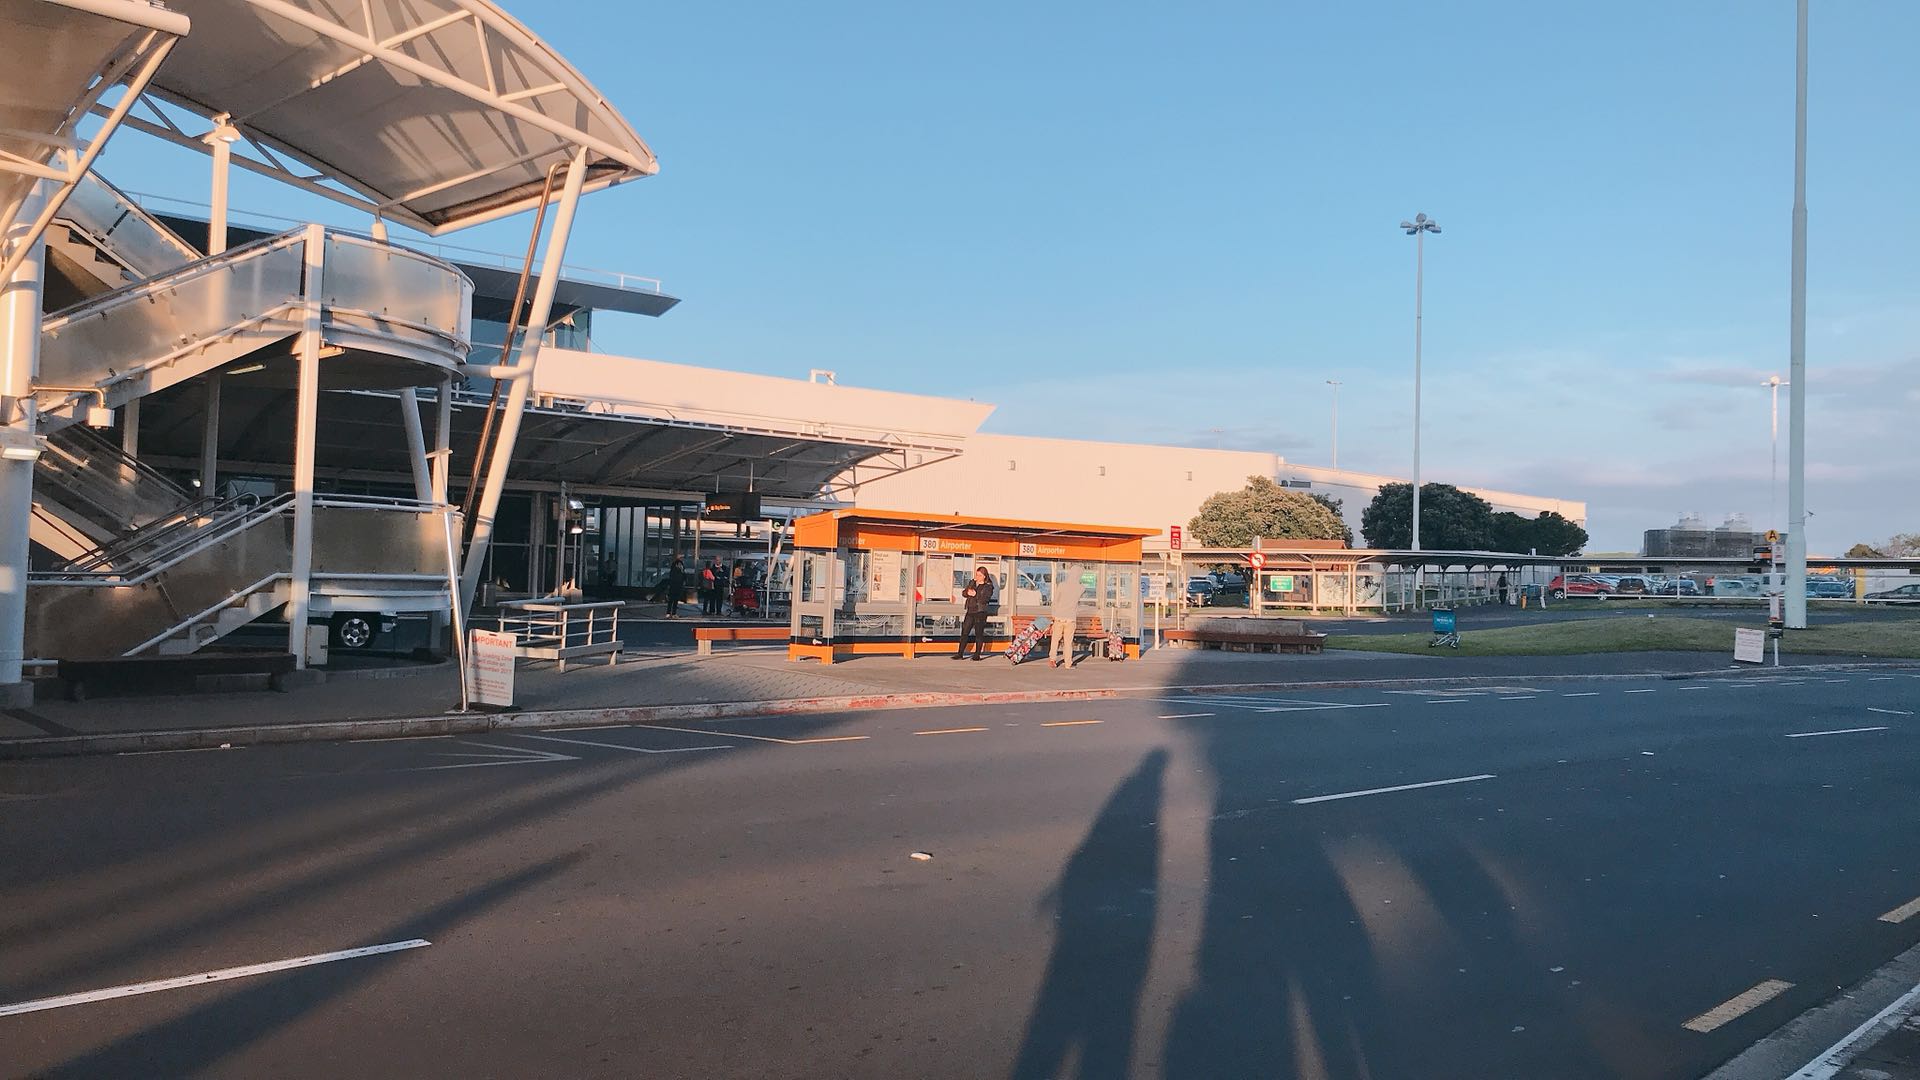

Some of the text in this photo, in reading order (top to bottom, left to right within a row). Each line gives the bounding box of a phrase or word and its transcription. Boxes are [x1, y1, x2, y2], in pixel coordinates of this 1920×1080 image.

[1768, 529, 1778, 540] A
[923, 540, 973, 550] 380 Airporter
[1022, 544, 1066, 555] 380 Airporter
[472, 635, 513, 648] IMPORTANT
